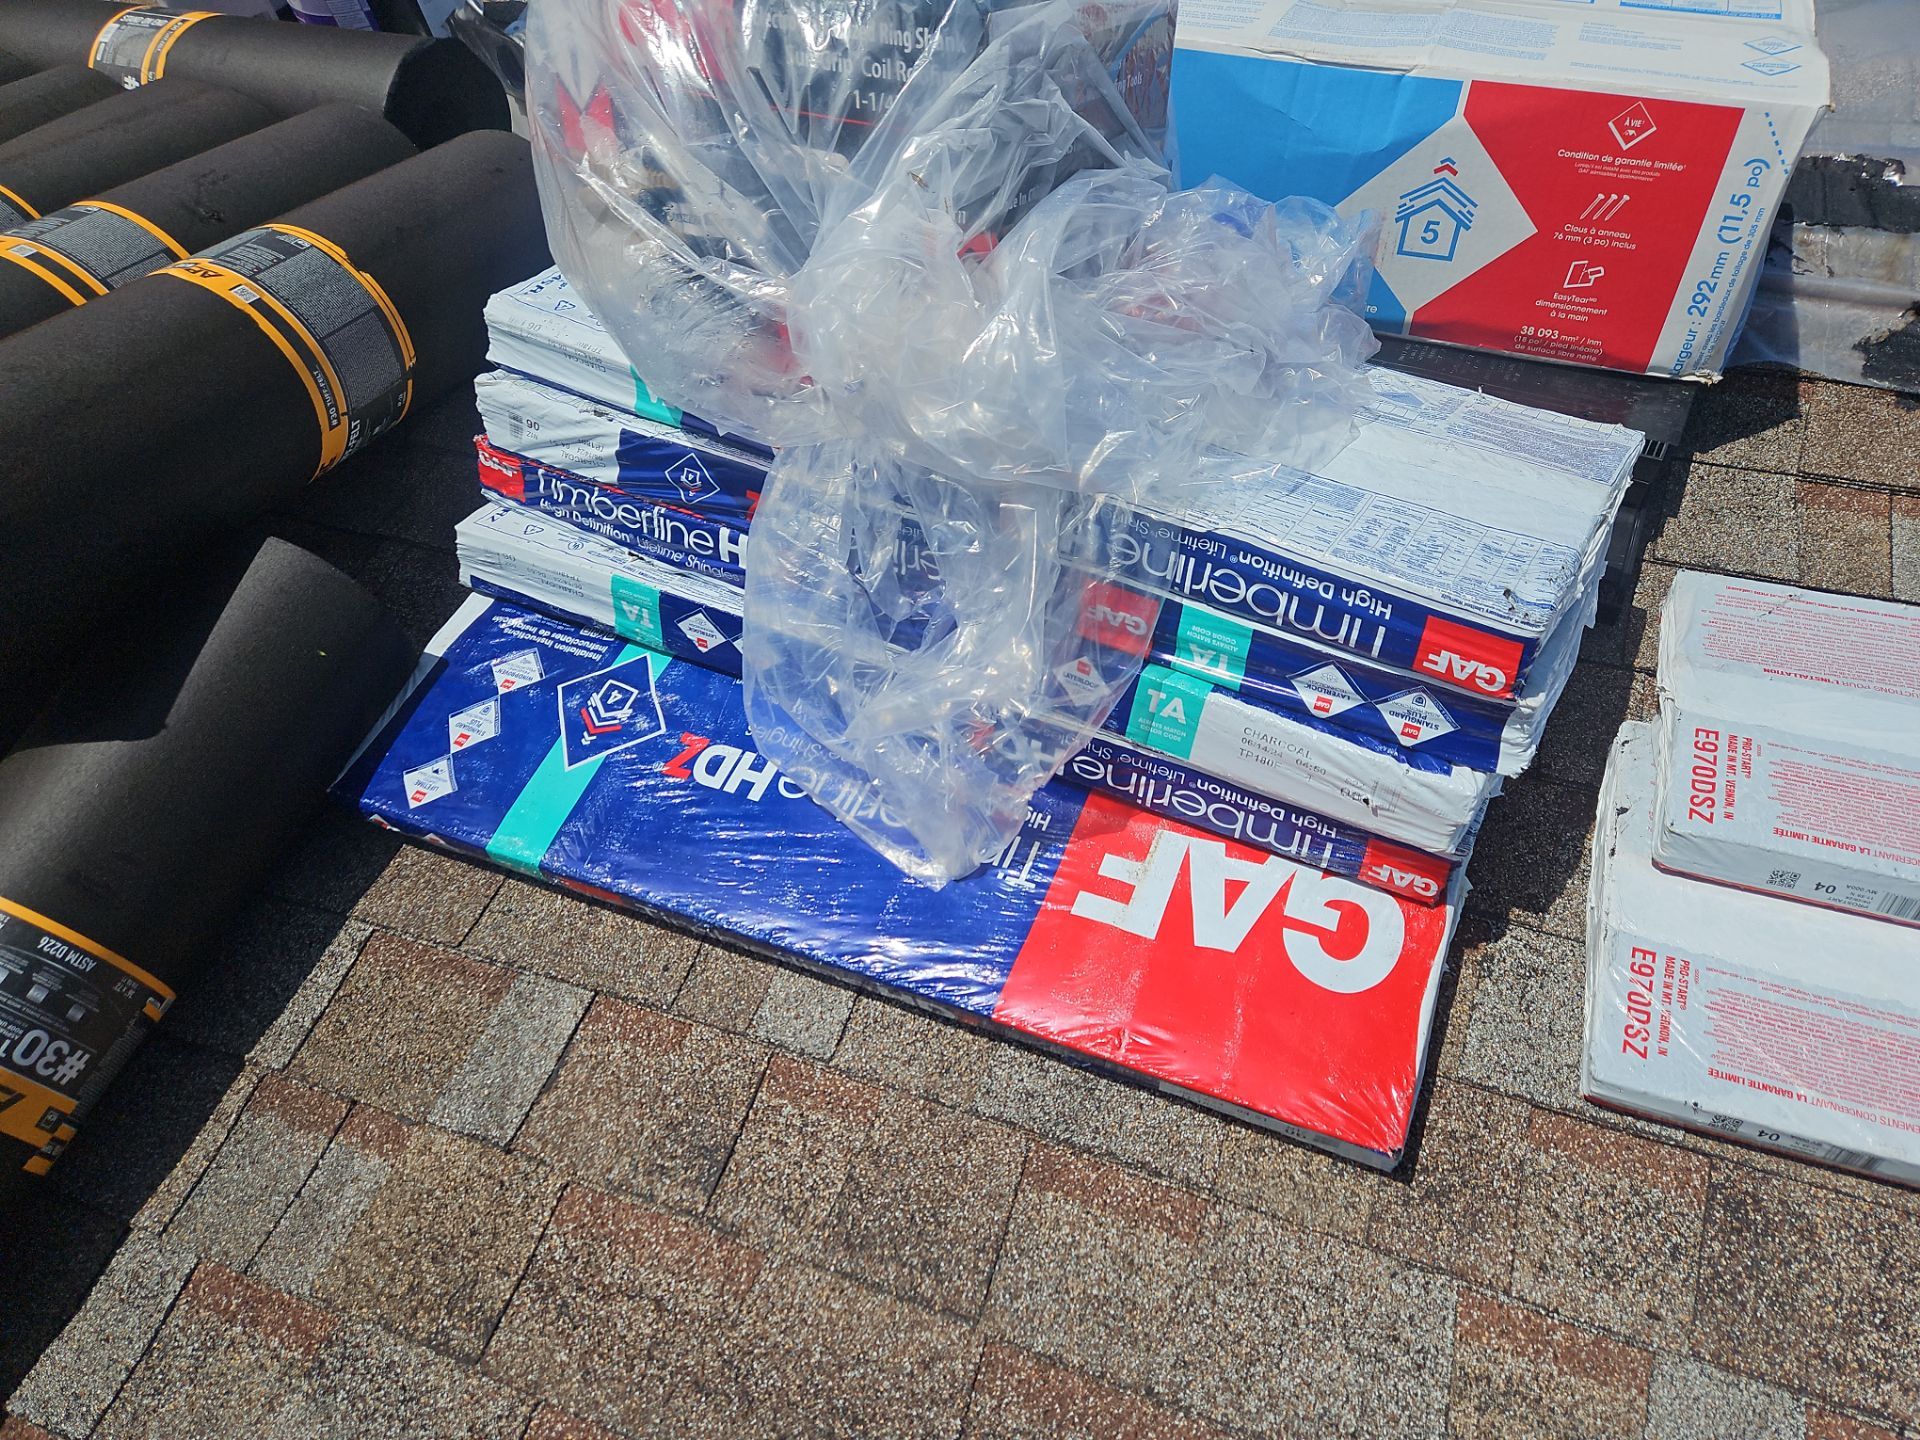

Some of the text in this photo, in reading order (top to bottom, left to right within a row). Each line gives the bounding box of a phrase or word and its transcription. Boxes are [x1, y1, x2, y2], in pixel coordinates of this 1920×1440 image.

[879, 23, 912, 53] Ring
[862, 56, 891, 80] Coil
[1557, 149, 1599, 161] Condition
[1601, 154, 1613, 163] de
[1614, 157, 1652, 168] garantie
[1743, 158, 1771, 188] po)
[1420, 220, 1440, 245] 5
[1564, 223, 1631, 240] Clous à anneau
[1717, 193, 1752, 244] (11,5
[1744, 239, 1753, 250] de
[1755, 207, 1765, 223] mm
[1553, 232, 1637, 250] 76 mm (3 po) inclus
[1710, 251, 1730, 279] mm
[1535, 300, 1608, 316] dimensionnement
[1687, 280, 1718, 318] 292
[1550, 310, 1588, 322] à la main
[1514, 335, 1527, 343] (18
[1550, 340, 1569, 349] pied
[1570, 342, 1603, 355] linéaire)
[1520, 325, 1535, 336] 38
[1537, 328, 1559, 339] 093
[1527, 345, 1556, 355] surface
[1557, 349, 1575, 358] libre
[1576, 352, 1597, 362] nette
[328, 407, 339, 427] #30
[539, 498, 570, 520] High
[685, 553, 741, 582] Shingles
[620, 600, 652, 628] TA
[1342, 588, 1393, 620] High
[1088, 604, 1148, 636] GAF
[503, 627, 601, 660] Installation Instructions
[552, 631, 607, 652] Instrucciones
[1422, 649, 1506, 692] GAF
[1763, 667, 1920, 699] UCTIONS POUR L'INSTALLATION
[1144, 688, 1186, 724] TA
[1388, 709, 1440, 731] STAINGUARD
[1406, 708, 1429, 720] PLUS
[1243, 727, 1314, 760] CHARCOAL
[1688, 727, 1720, 825] E970DSZ
[1723, 734, 1739, 820] MADE IN MT. VERNON, IN
[1292, 812, 1337, 838] High
[1772, 826, 1920, 867] CERNANT LA GARANTIE LIMITÉE
[1368, 863, 1439, 898] GAF
[1813, 881, 1836, 894] 04
[1071, 829, 1405, 994] GAF
[37, 936, 96, 972] ASTM D226
[1664, 956, 1676, 977] MADE
[1663, 977, 1674, 986] IN
[1622, 946, 1657, 1060] E970DSZ
[1662, 987, 1673, 1005] MT.
[11, 1029, 91, 1085] #30
[1658, 1046, 1668, 1056] IN
[1707, 1066, 1877, 1121] CONCERNANT LA GARANTIE LIMITÉE
[1758, 1129, 1781, 1142] 04
